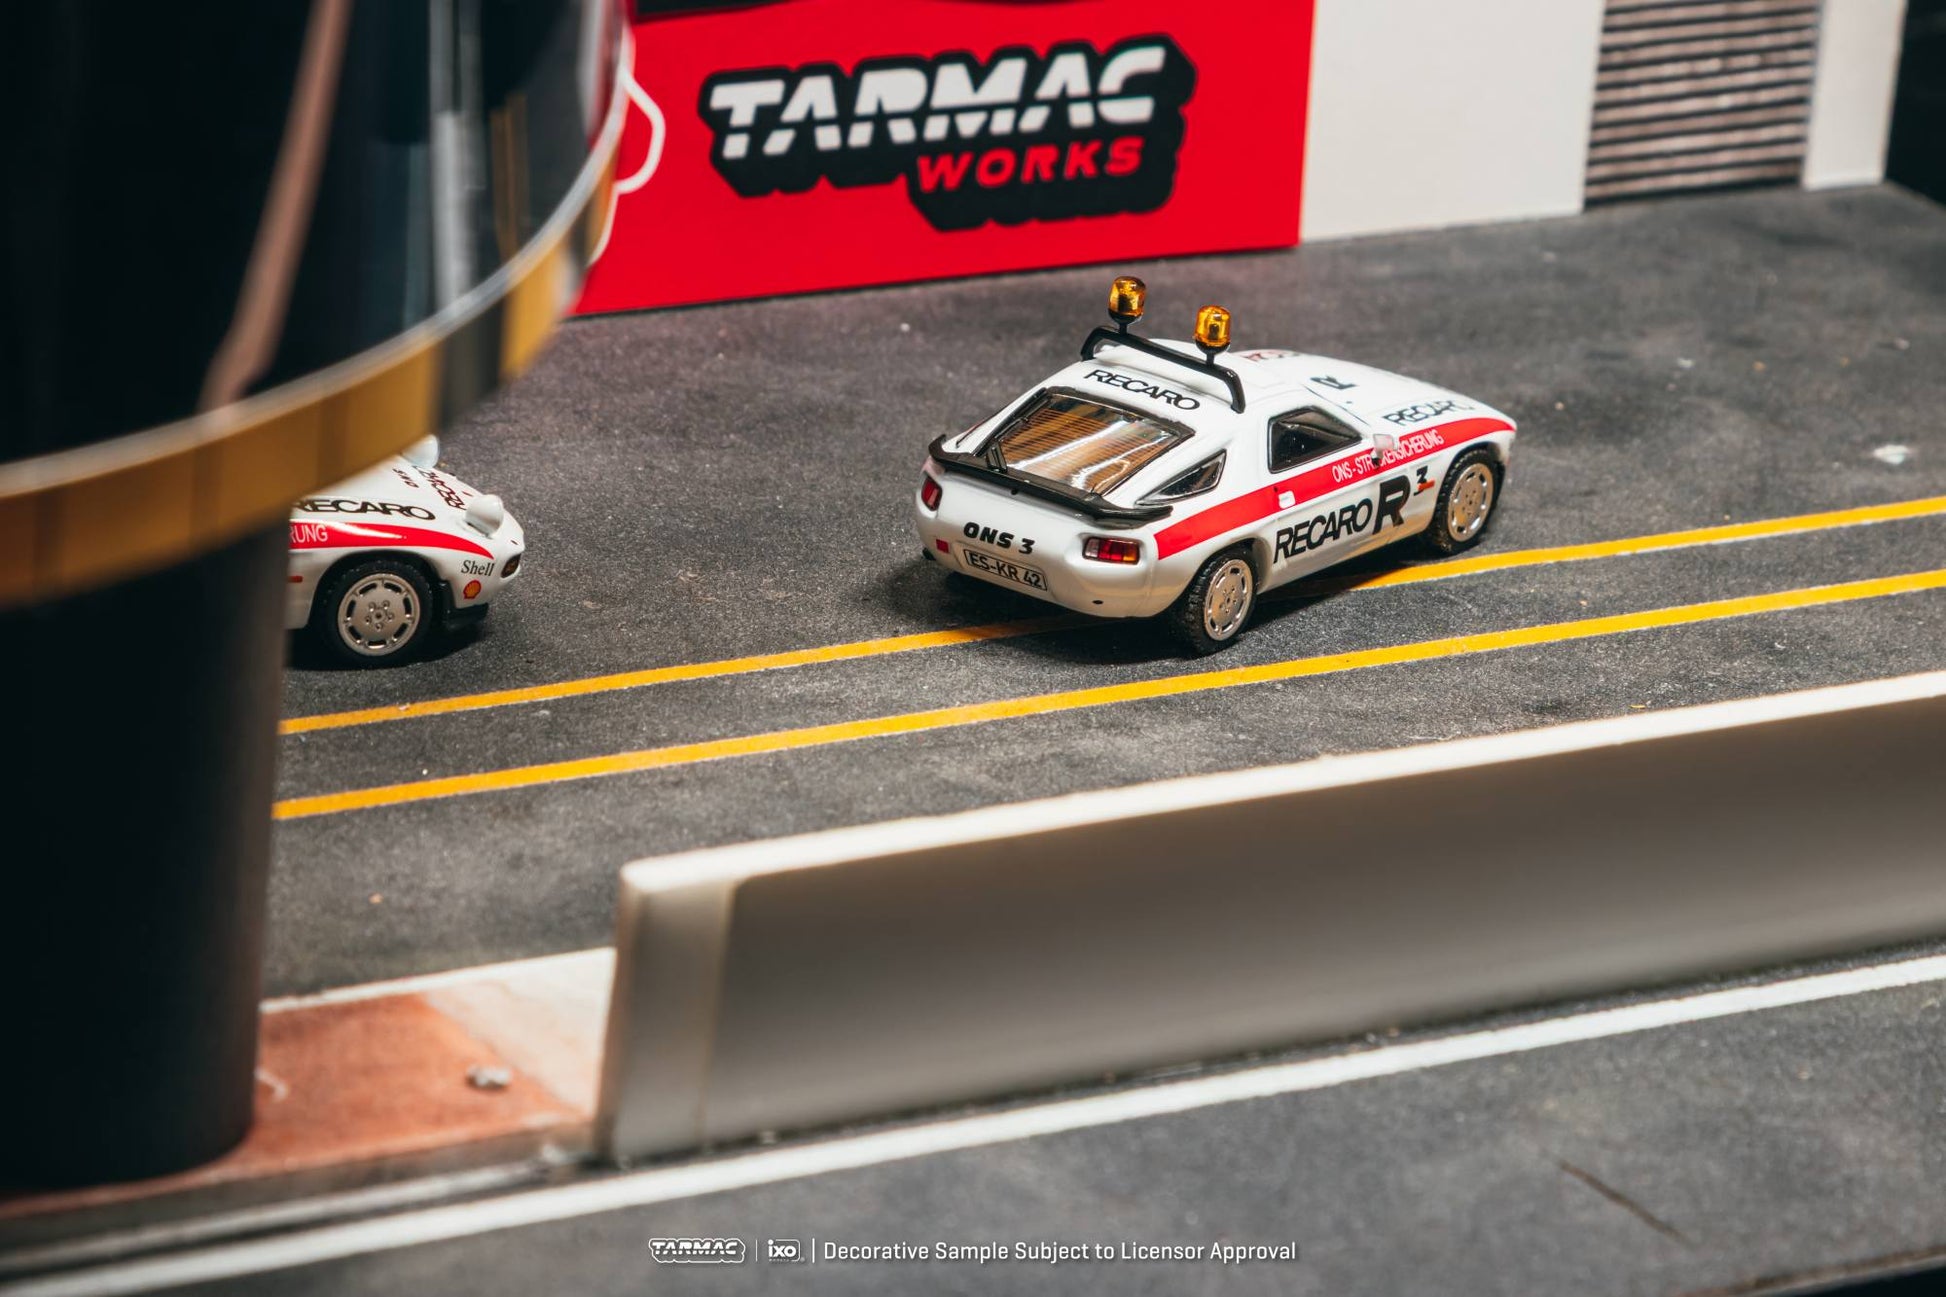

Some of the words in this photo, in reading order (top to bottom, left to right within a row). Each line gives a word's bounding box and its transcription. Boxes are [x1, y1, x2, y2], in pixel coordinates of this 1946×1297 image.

[709, 46, 1166, 159] TARMAC
[916, 136, 1143, 193] WORKS
[1083, 369, 1200, 411] RECARO
[964, 522, 1014, 548] ONS
[1019, 538, 1035, 554] 3
[1273, 497, 1373, 564] RECARO
[460, 559, 495, 577] Shell
[969, 553, 1020, 582] ES-KR
[1023, 570, 1043, 588] 42
